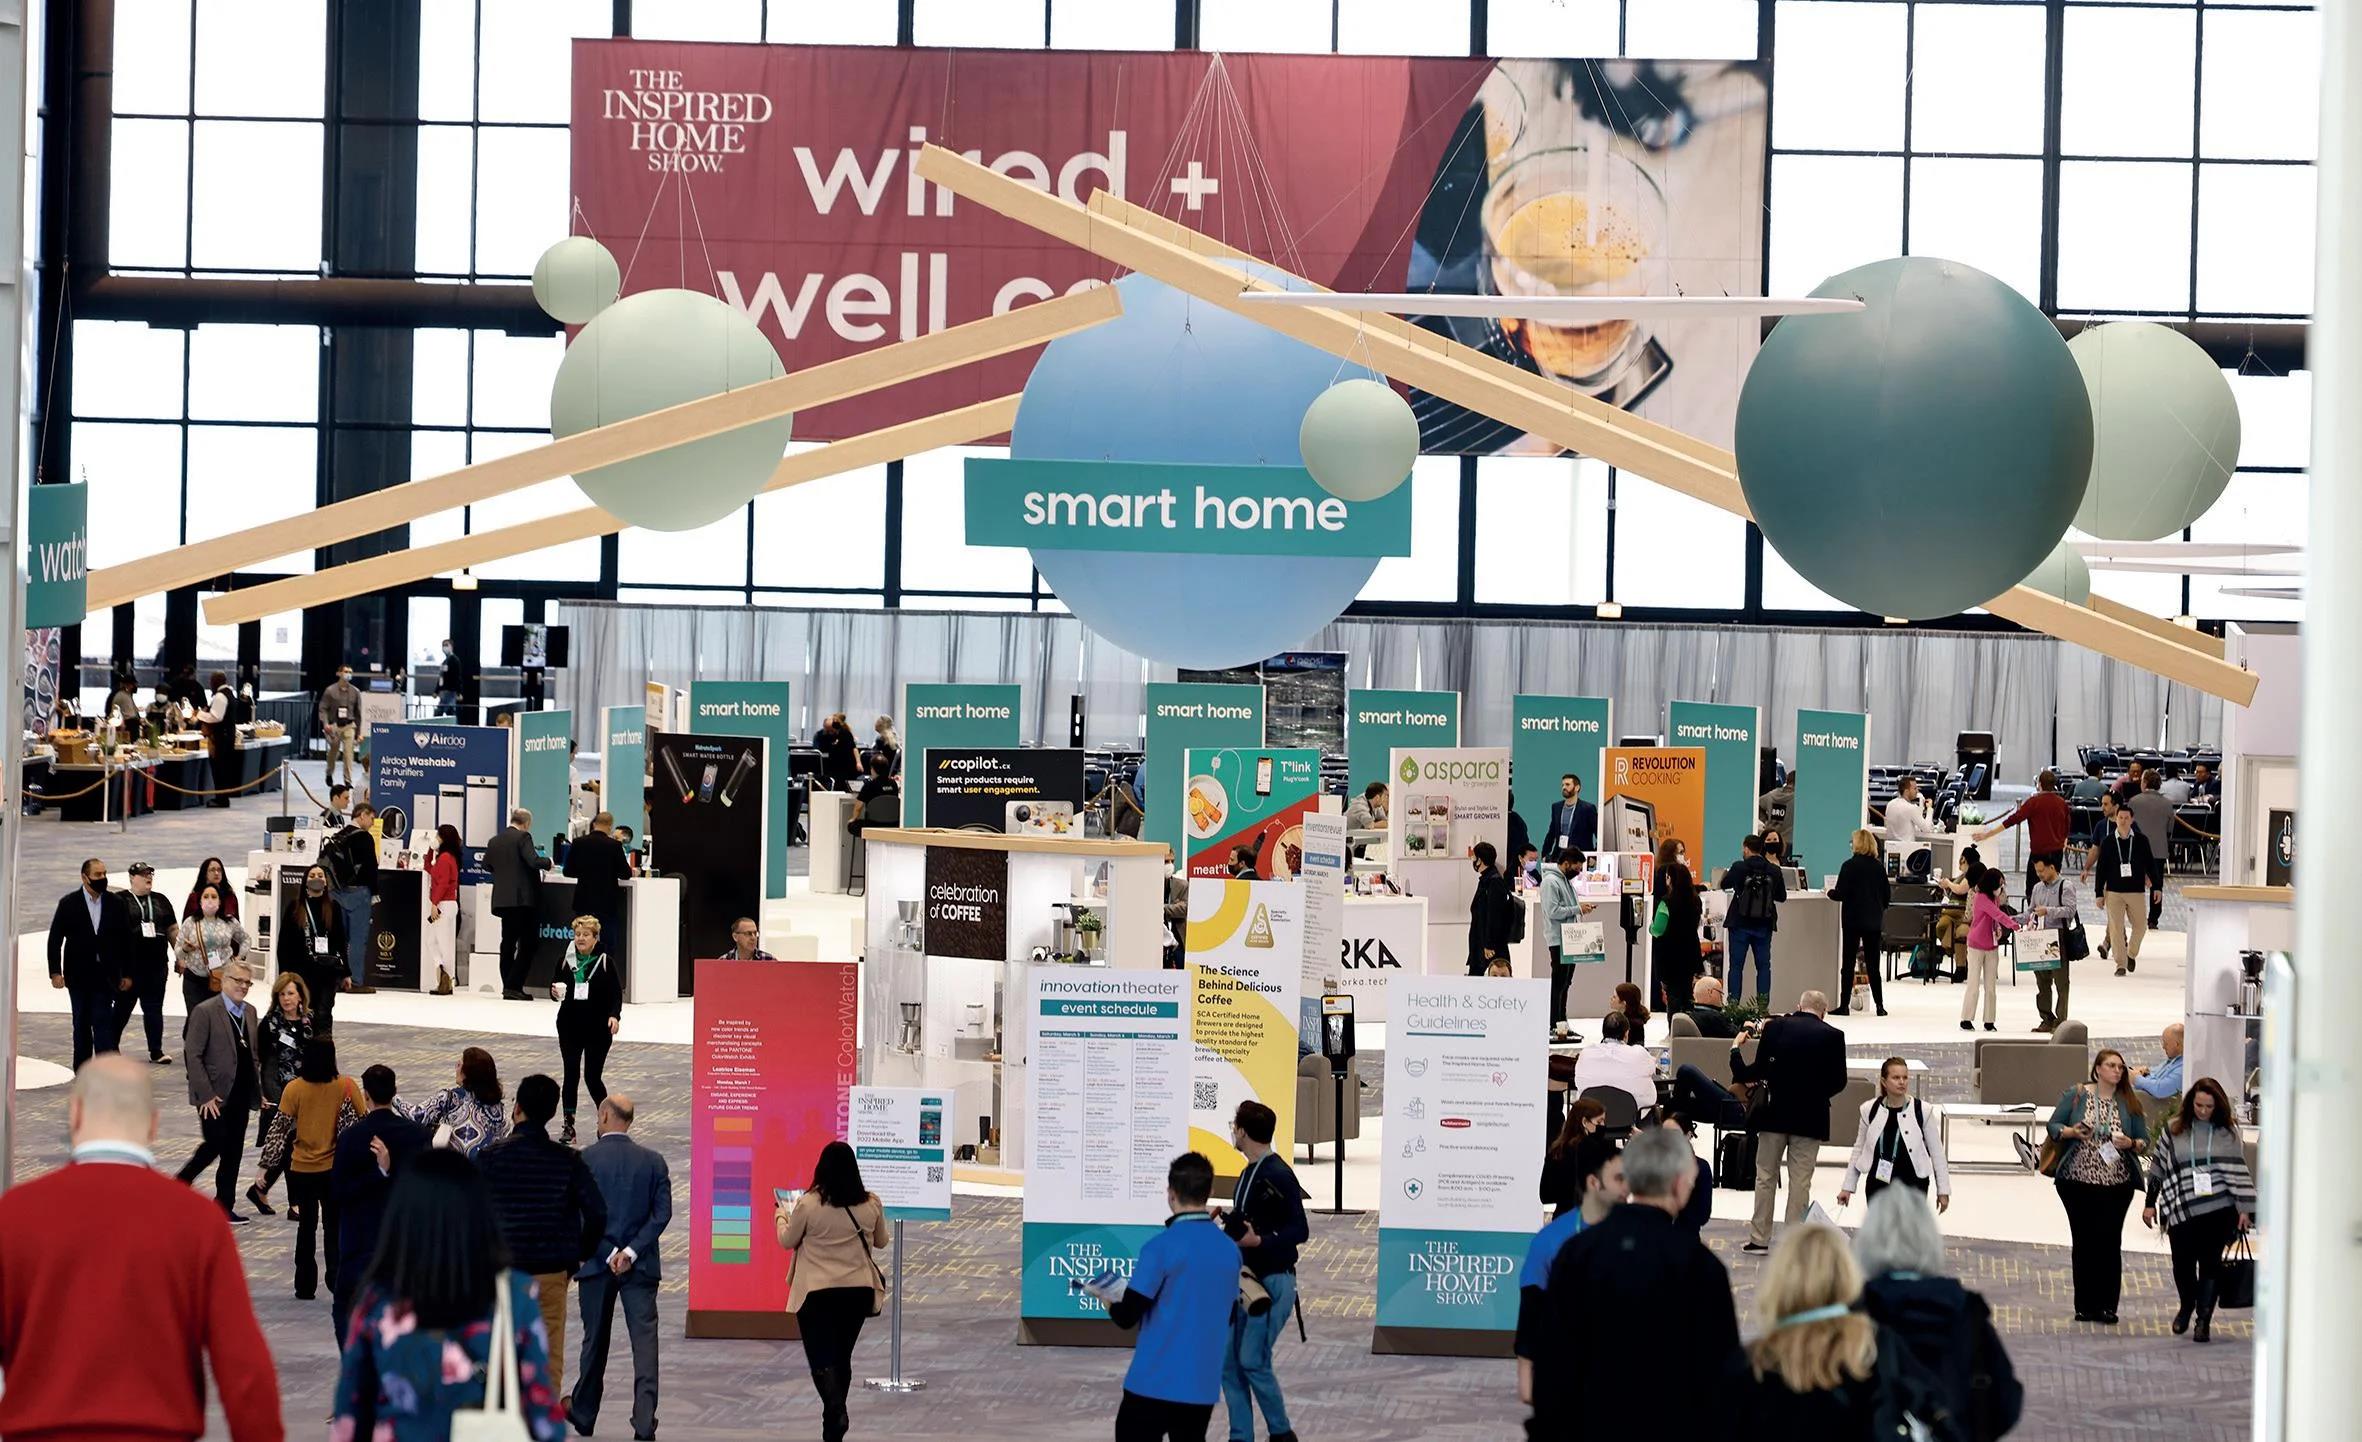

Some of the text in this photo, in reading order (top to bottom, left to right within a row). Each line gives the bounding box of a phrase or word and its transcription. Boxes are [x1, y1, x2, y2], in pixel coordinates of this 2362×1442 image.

[630, 69, 683, 90] THE
[602, 90, 773, 123] INSPIRED
[629, 122, 746, 154] HOME
[717, 252, 948, 342] well
[1023, 485, 1348, 531] smart home
[700, 701, 781, 717] smart home
[916, 703, 1010, 719] smart home
[1157, 703, 1253, 719] smart home
[1359, 710, 1448, 726] smart home
[1521, 716, 1600, 732] smart home
[611, 728, 642, 746] smart home
[1677, 723, 1749, 741] smart home
[1802, 731, 1859, 749] smart home
[431, 732, 466, 749] Airdog
[525, 733, 567, 752] smart home
[380, 756, 456, 768] Airdog Washable
[1632, 757, 1696, 770] REVOLUTION
[380, 767, 425, 777] Air Purifiers
[1424, 760, 1499, 785] aspara
[380, 778, 407, 789] Family
[936, 776, 1035, 786] Smart products require
[936, 786, 962, 794] smart
[983, 786, 1041, 796] engagement.
[930, 881, 999, 904] celebration
[930, 903, 982, 922] of COFFEE
[1199, 964, 1260, 977] The Science
[1040, 979, 1179, 995] innovation theater
[1198, 979, 1282, 993] Behind Delicious
[1197, 994, 1233, 1005] Coffee
[1406, 993, 1528, 1013] Health & Safety
[837, 965, 855, 1067] ColorWatch
[1061, 1003, 1158, 1015] event schedule
[1196, 1010, 1211, 1018] SCA
[1212, 1011, 1240, 1019] Certified
[1235, 1022, 1263, 1030] designed
[1406, 1014, 1488, 1031] Guidelines
[1204, 1029, 1228, 1037] provide
[1241, 1031, 1264, 1039] highest
[1195, 1046, 1250, 1056] brewing specialty
[1224, 1056, 1244, 1064] home.
[1066, 1243, 1102, 1257] THE
[1425, 1241, 1459, 1255] THE
[1049, 1256, 1139, 1278] INSPIRE
[1408, 1253, 1515, 1275] INSPIRED
[1425, 1272, 1498, 1293] HOME
